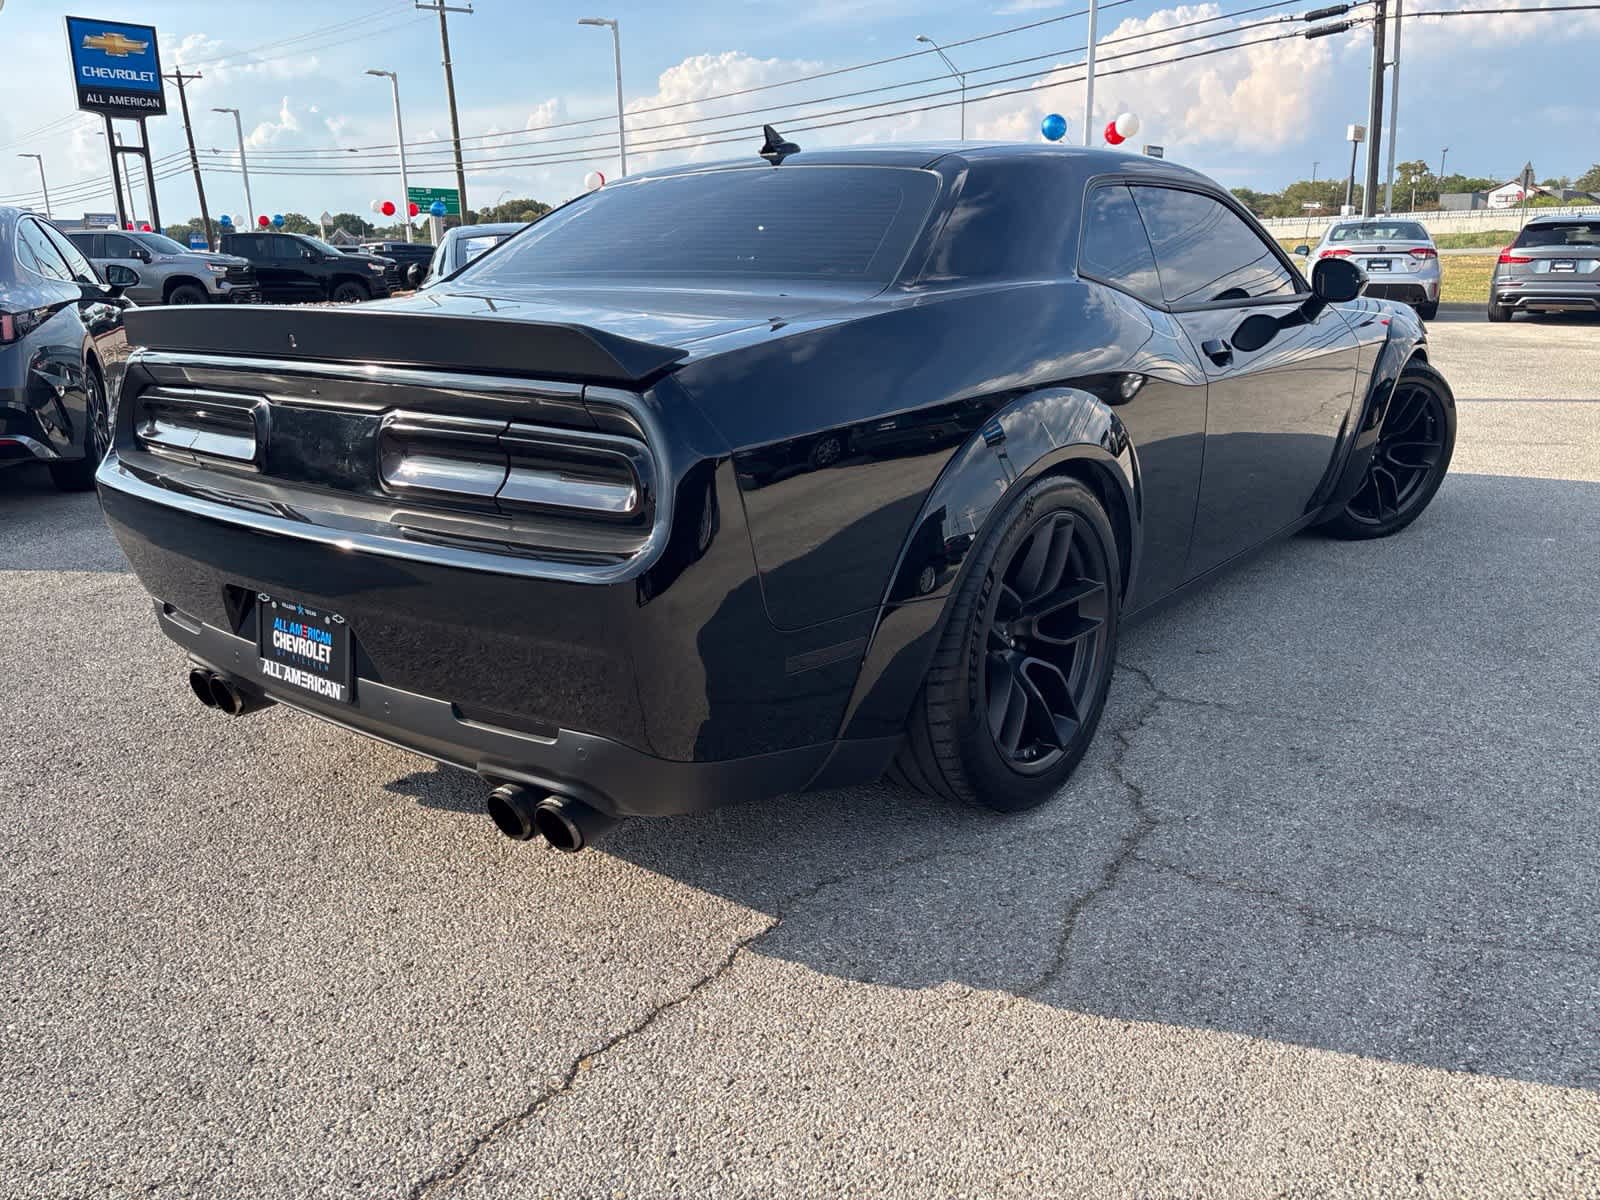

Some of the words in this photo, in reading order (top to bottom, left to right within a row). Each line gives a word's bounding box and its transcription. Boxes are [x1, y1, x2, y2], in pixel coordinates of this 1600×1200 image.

[82, 66, 154, 82] CHEVROLET
[86, 93, 106, 104] ALL
[109, 95, 160, 107] AMERICAN
[274, 617, 288, 633] ALL
[289, 622, 332, 645] AMERICAN
[273, 629, 332, 664] CHEVROLET
[261, 657, 282, 679] ALL
[282, 664, 342, 700] AMERICAN
